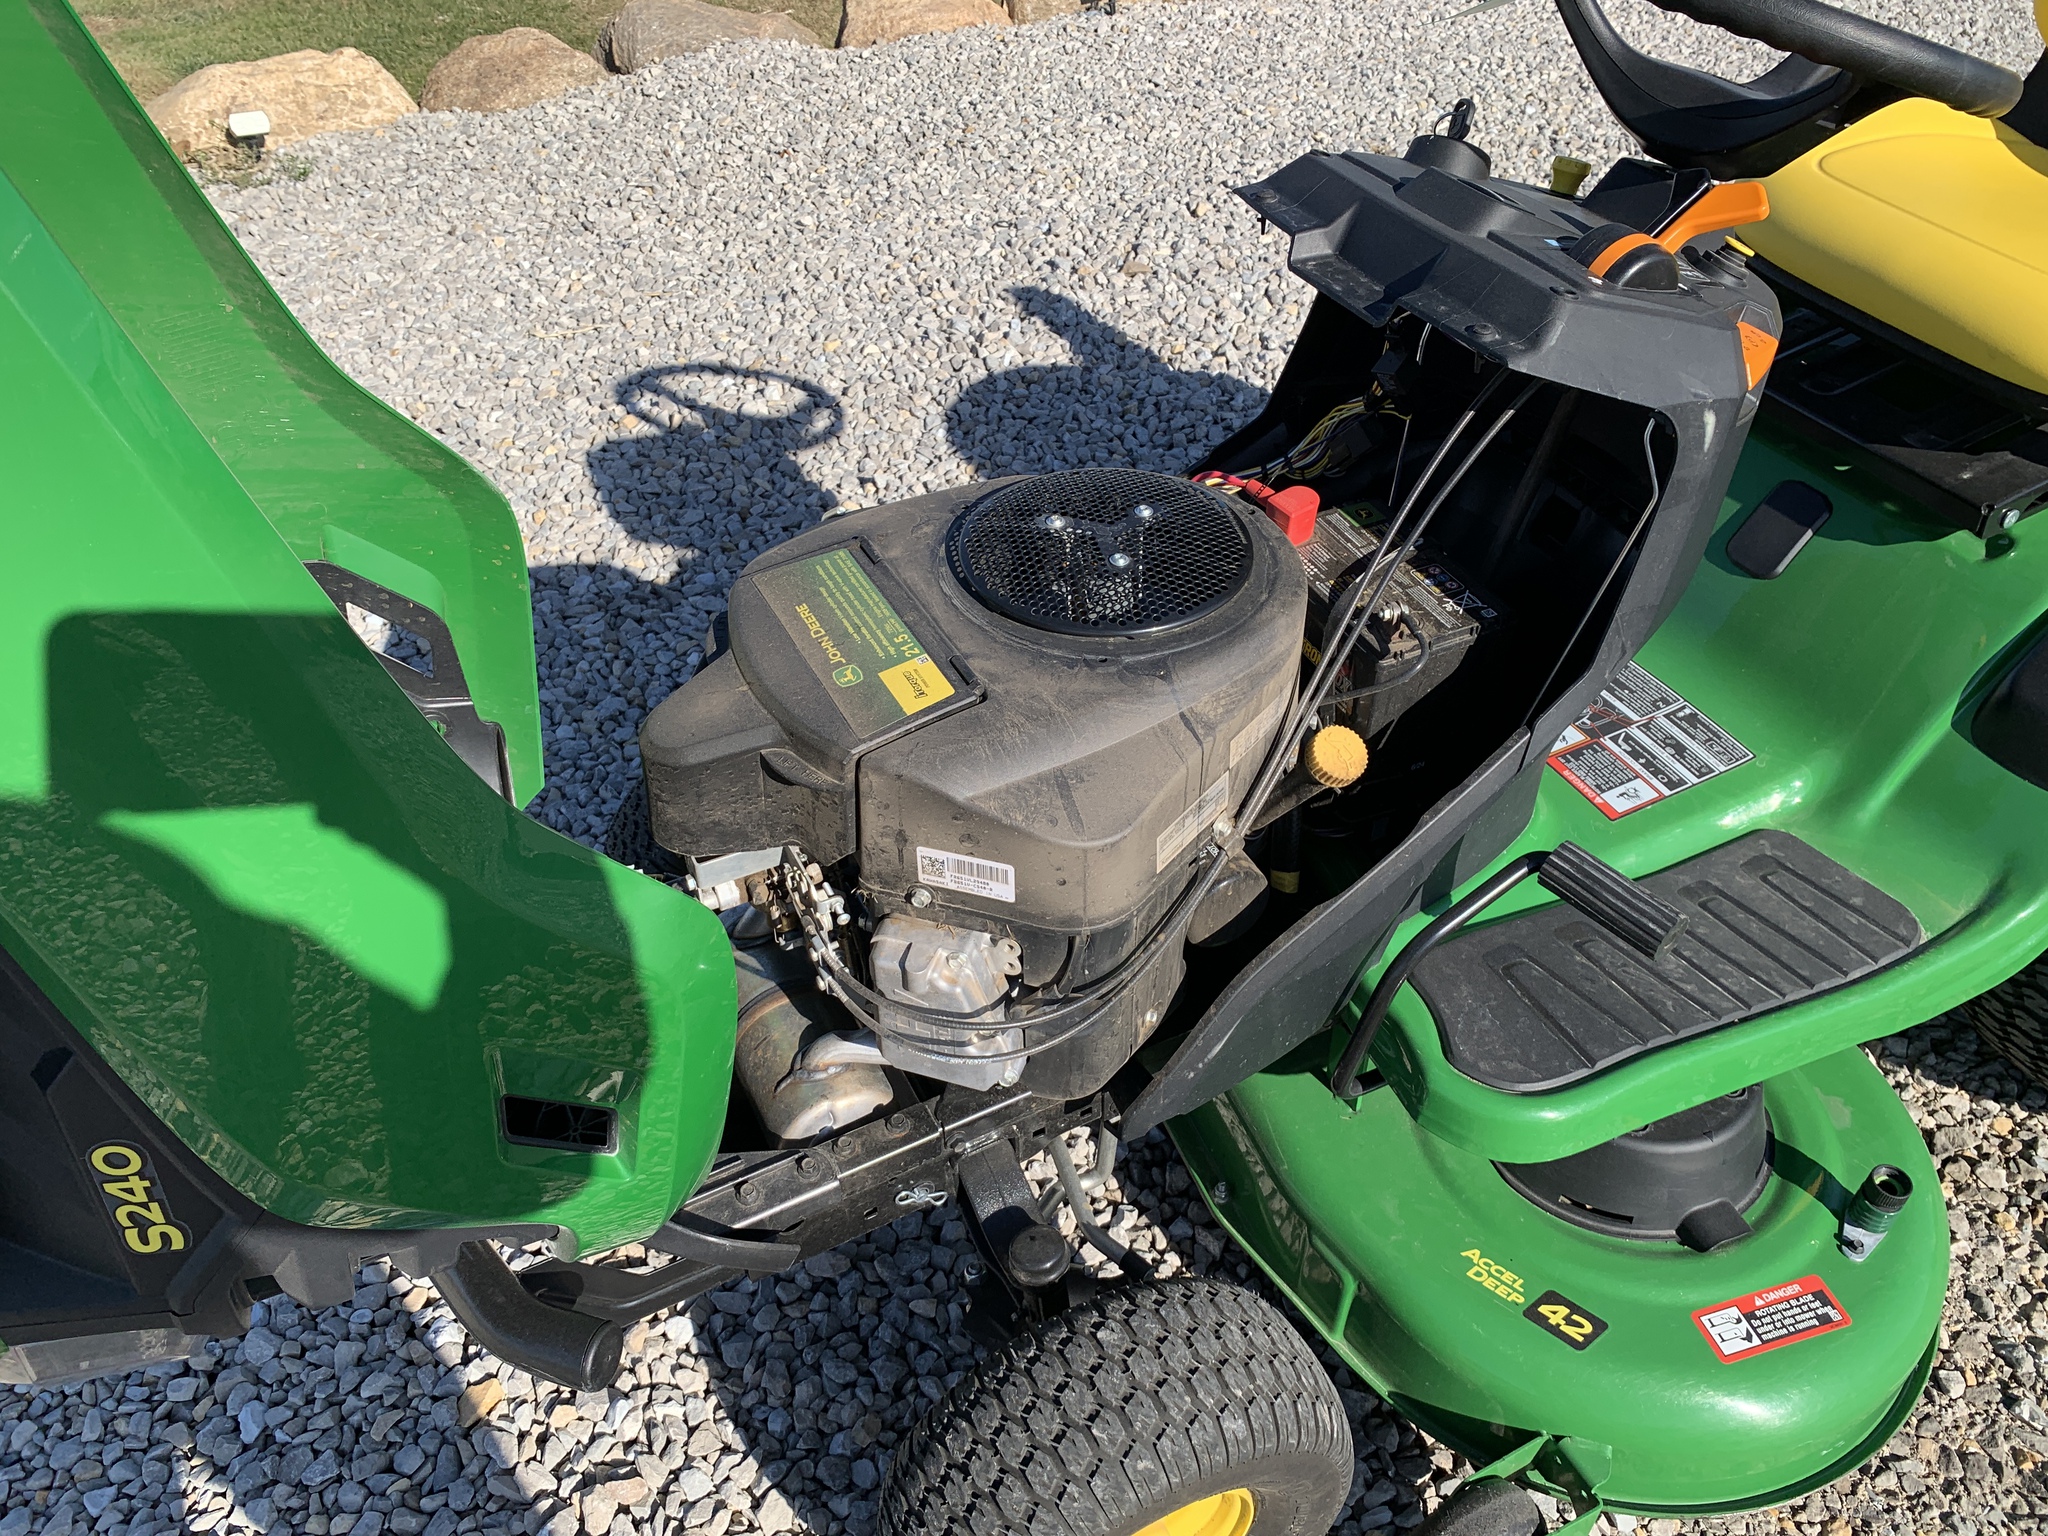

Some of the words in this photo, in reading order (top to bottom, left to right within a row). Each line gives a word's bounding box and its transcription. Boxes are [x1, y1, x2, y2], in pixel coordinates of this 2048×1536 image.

[794, 602, 825, 639] DEERE
[816, 635, 847, 665] JOHN
[893, 632, 920, 657] 21.5
[1561, 768, 1597, 797] DANGER
[922, 876, 948, 886] KAWASAKI
[91, 1145, 185, 1253] S240
[1460, 1248, 1525, 1293] ACCEL
[1465, 1265, 1525, 1307] DEEP
[1760, 1282, 1803, 1302] DANGER
[1749, 1317, 1763, 1327] Do
[1759, 1314, 1773, 1324] not
[1770, 1311, 1785, 1322] put
[1781, 1305, 1802, 1317] hands
[1806, 1299, 1822, 1309] feet
[1753, 1300, 1791, 1317] ROTATING
[1788, 1293, 1815, 1306] BLADE
[1755, 1322, 1776, 1334] under
[1773, 1320, 1784, 1328] or
[1781, 1316, 1796, 1326] into
[1793, 1310, 1817, 1322] mower
[1814, 1304, 1834, 1315] when
[1536, 1303, 1595, 1344] 42
[1759, 1326, 1789, 1341] machine
[1786, 1324, 1796, 1332] is
[1793, 1317, 1820, 1331] running
